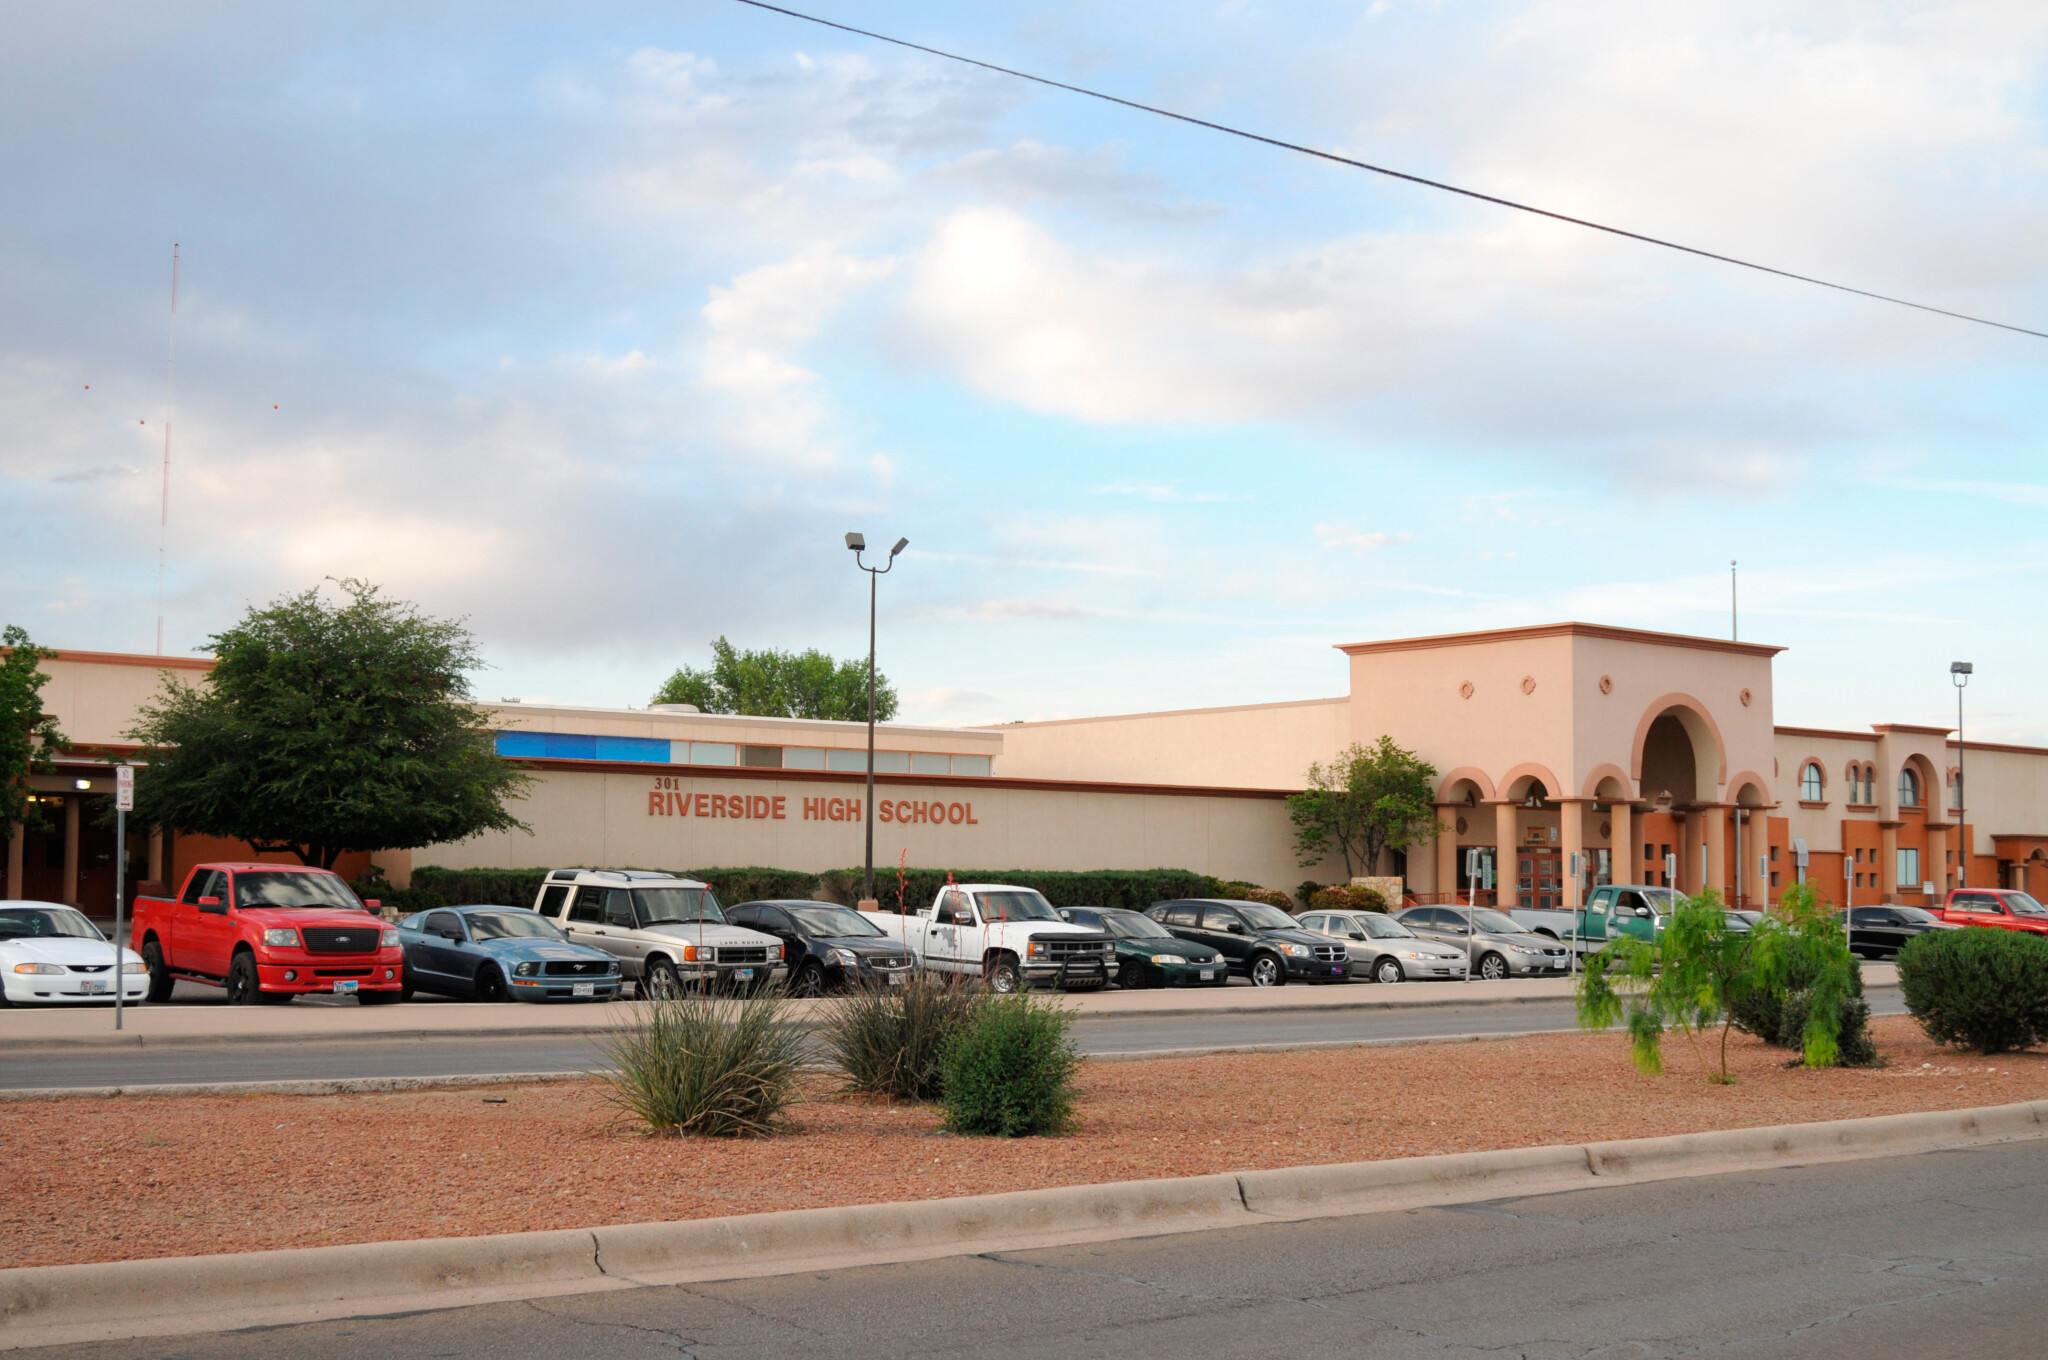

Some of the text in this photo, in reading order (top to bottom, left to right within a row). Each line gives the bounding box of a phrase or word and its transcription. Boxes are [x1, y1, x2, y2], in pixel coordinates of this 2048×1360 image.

[654, 777, 680, 790] 301
[649, 791, 979, 824] RIVERSIDE HIGH SCHOOL
